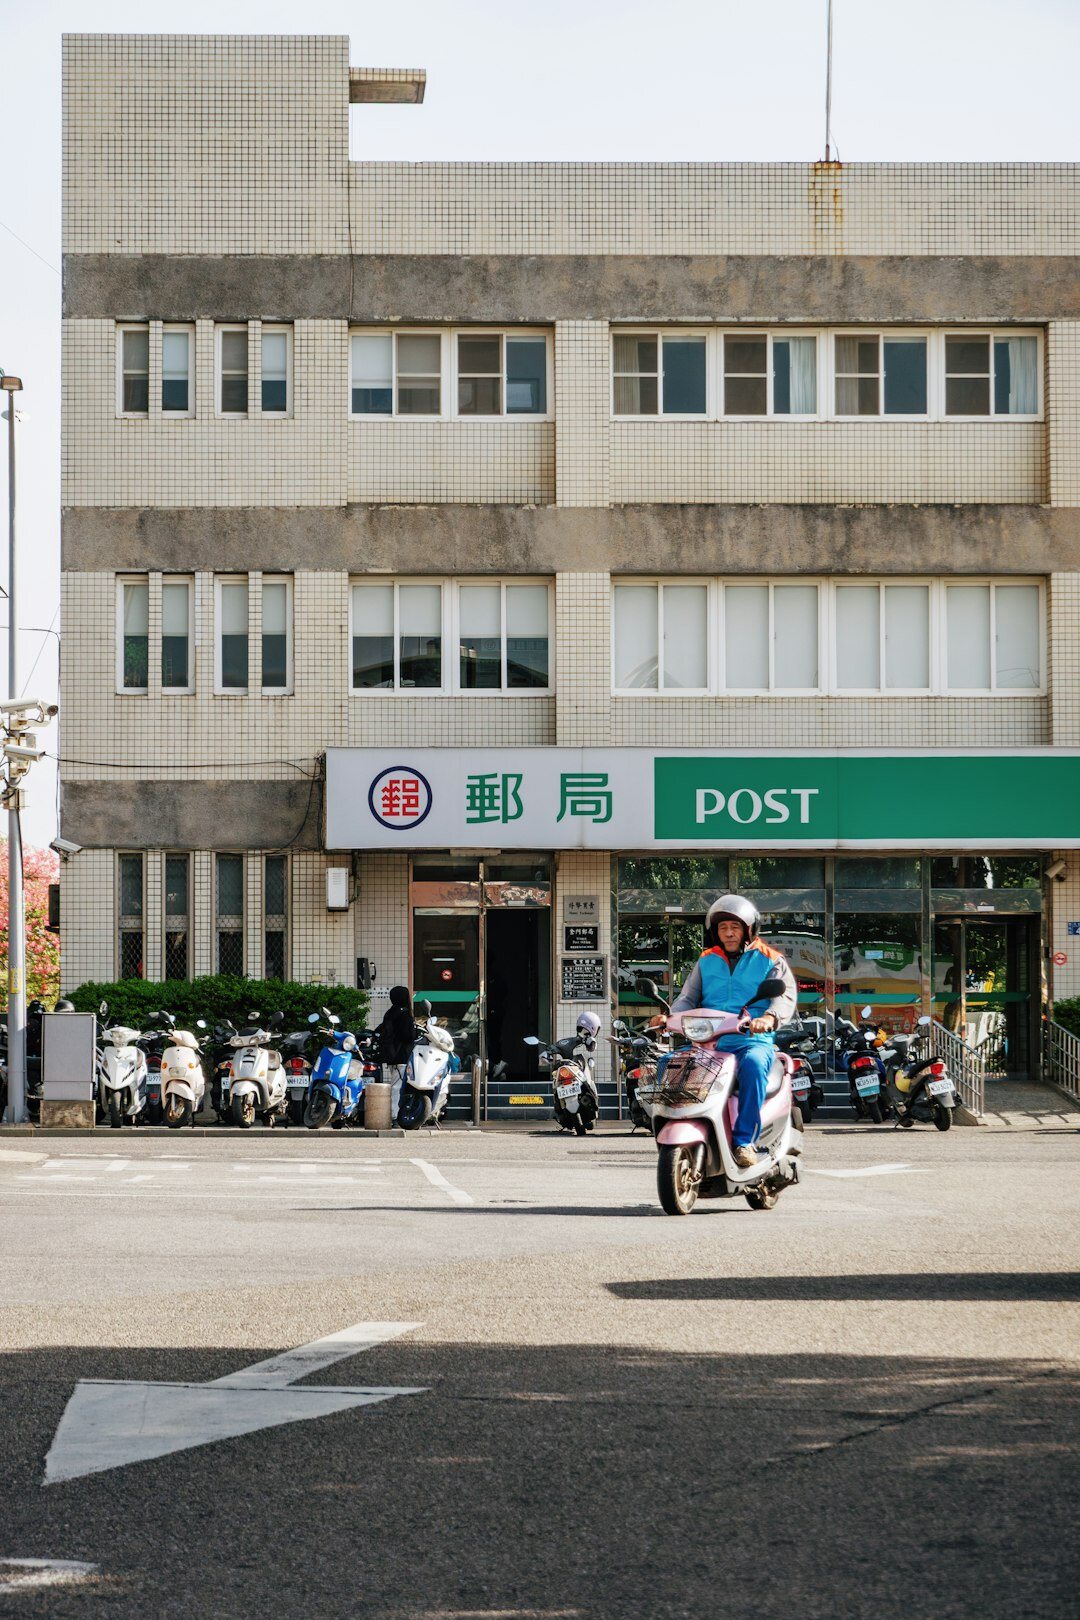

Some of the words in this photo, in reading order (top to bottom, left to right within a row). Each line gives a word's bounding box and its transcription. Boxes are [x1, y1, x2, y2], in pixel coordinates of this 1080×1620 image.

[381, 779, 419, 816] 郵
[466, 773, 613, 824] 郵局
[696, 788, 819, 824] POST
